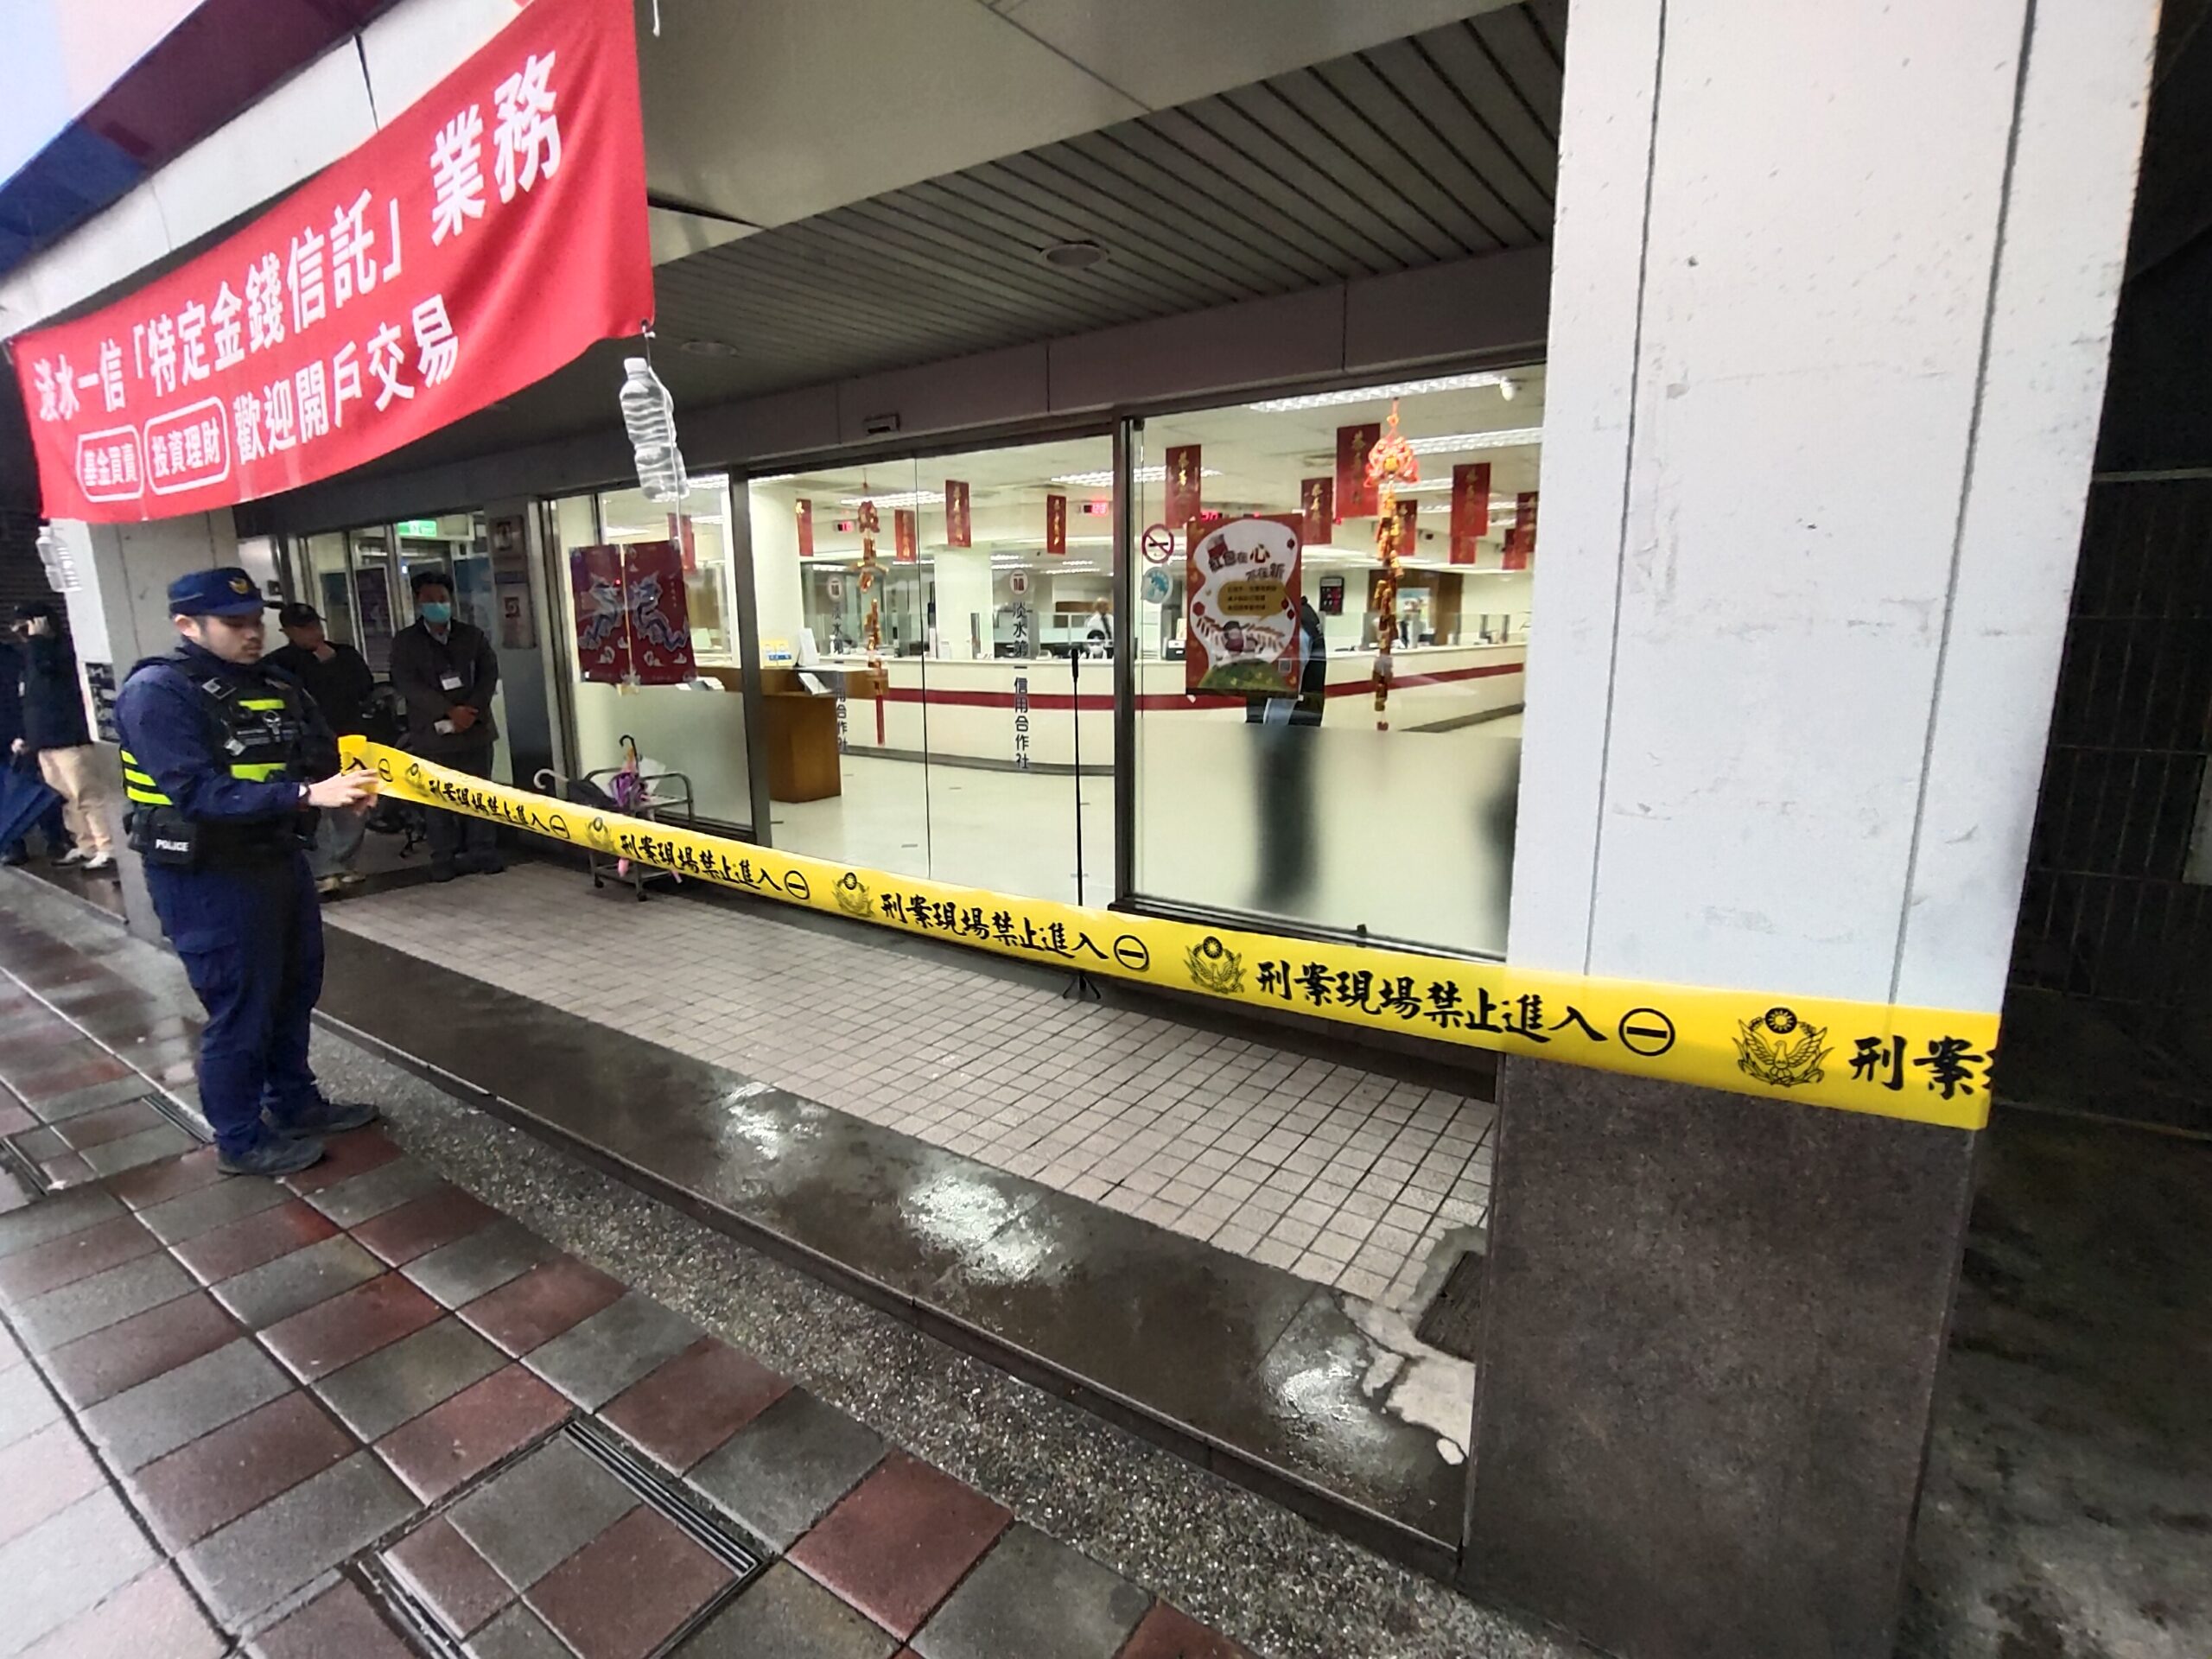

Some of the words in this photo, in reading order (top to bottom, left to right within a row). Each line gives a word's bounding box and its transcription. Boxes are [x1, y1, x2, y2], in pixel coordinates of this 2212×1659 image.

[151, 416, 221, 478] 投資理財
[232, 294, 459, 465] 歡迎開戶交易
[1012, 601, 1030, 770] 淡水第一信用合作社
[155, 838, 189, 852] POLICE
[429, 779, 550, 834] 刑案現場禁止進入
[620, 834, 784, 891] 刑案現場禁止進入
[880, 893, 1109, 960] 刑案現場禁止進入
[1255, 959, 1608, 1044] 刑案現場禁止進入
[1848, 1034, 1993, 1101] 刑案
